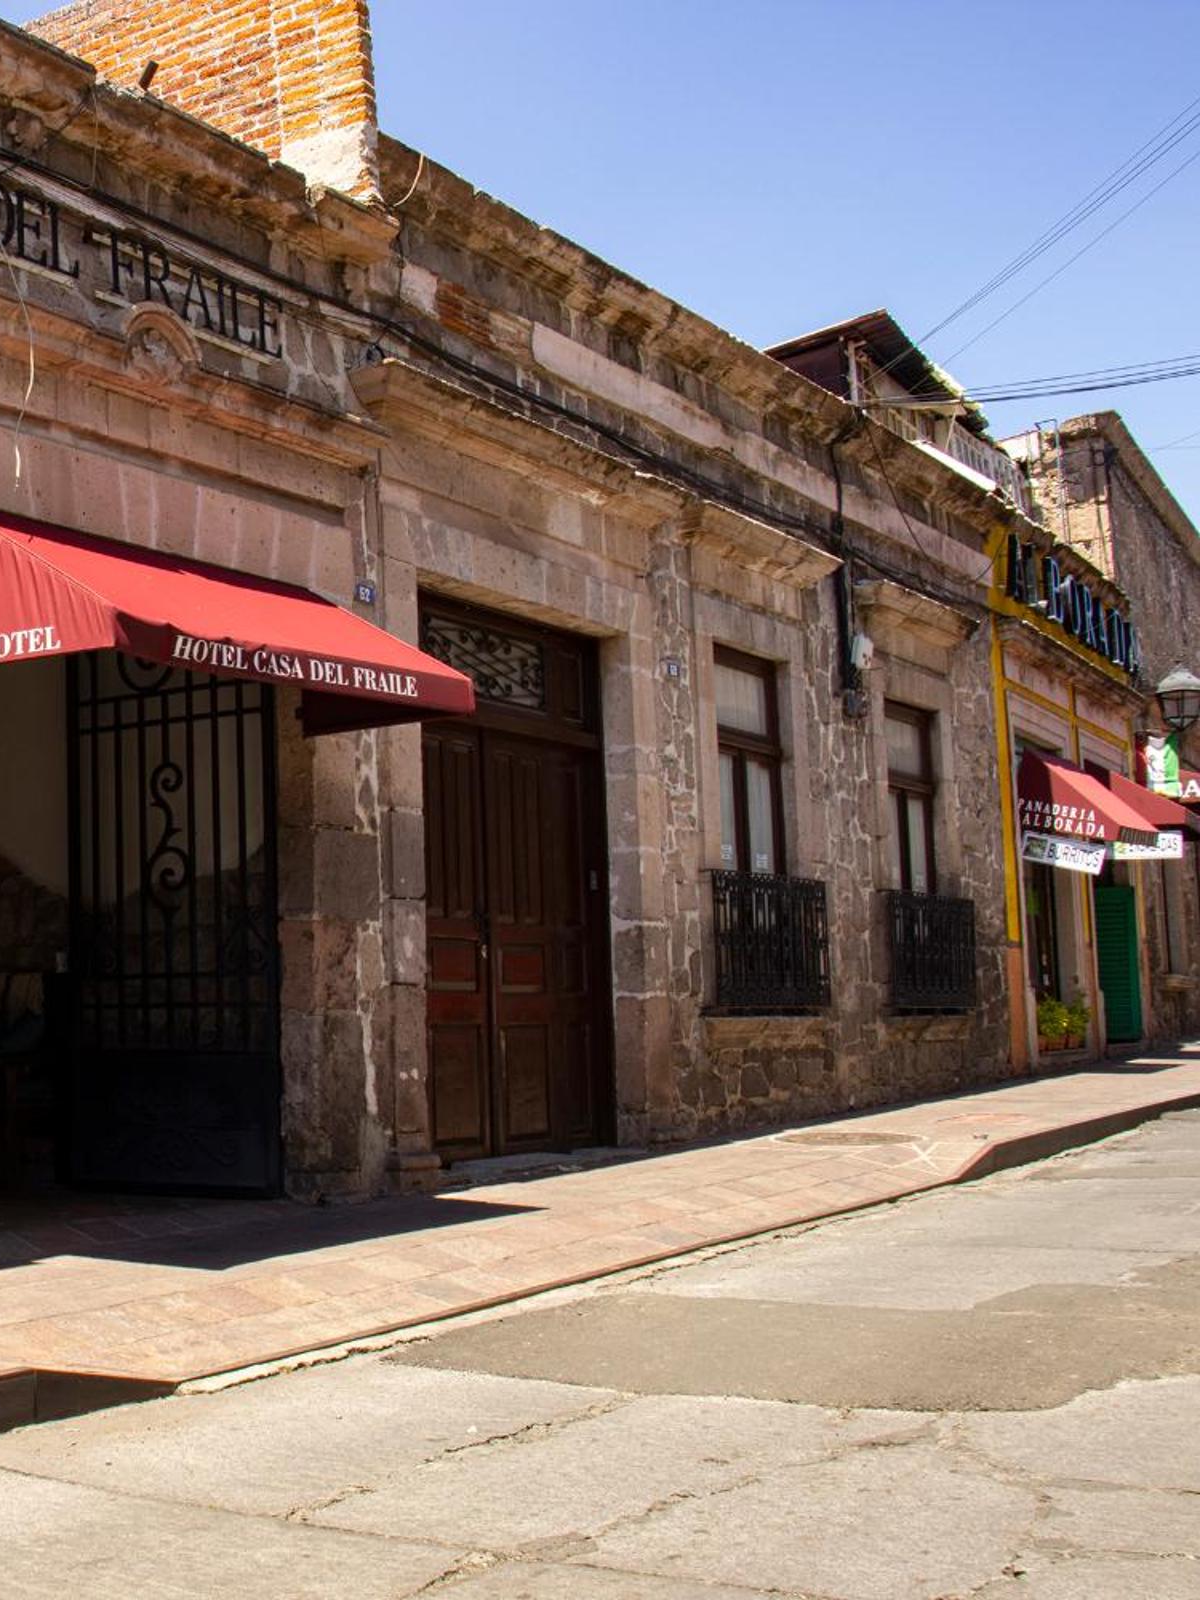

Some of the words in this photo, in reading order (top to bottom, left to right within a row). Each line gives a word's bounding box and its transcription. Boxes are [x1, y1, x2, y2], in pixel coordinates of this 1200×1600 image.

[110, 229, 283, 358] FRAILE
[172, 634, 248, 670] HOTEL
[253, 650, 304, 679] CASA
[310, 659, 349, 686] DEL
[353, 666, 418, 697] FRAILE
[1017, 798, 1096, 822] PANADERIA
[1022, 813, 1106, 838] ALBORADA
[1047, 842, 1101, 869] BURRITOS
